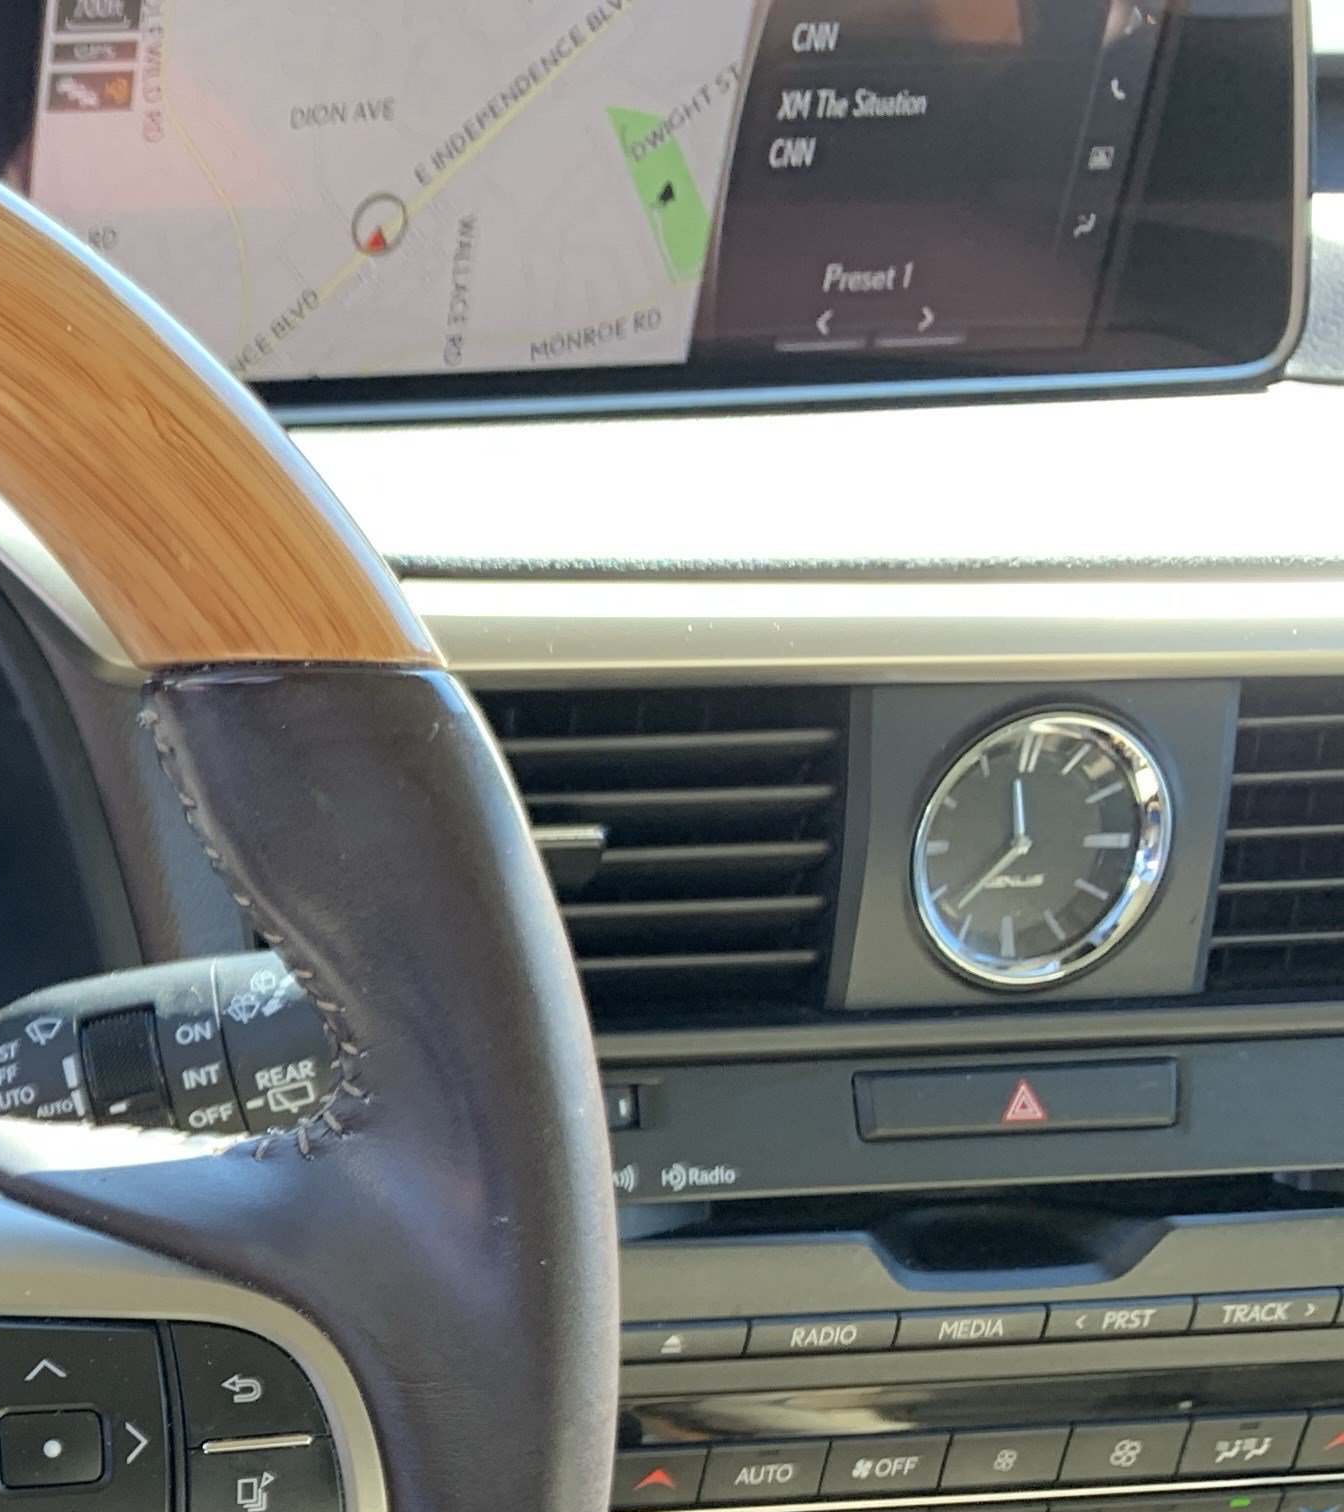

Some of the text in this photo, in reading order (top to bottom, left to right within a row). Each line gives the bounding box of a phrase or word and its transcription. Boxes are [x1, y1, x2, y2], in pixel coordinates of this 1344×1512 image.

[792, 22, 839, 52] CNN
[290, 97, 396, 130] DION AVE
[414, 163, 432, 187] E
[432, 24, 586, 174] INDEPENDENCE
[630, 62, 740, 163] DWIGHT ST
[776, 89, 928, 120] XM The Situation
[768, 138, 816, 168] CNN
[442, 216, 479, 367] WALLACE RD
[822, 262, 914, 293] Preset 1
[270, 288, 319, 340] BLVD
[529, 308, 662, 361] MONROE RD
[174, 1022, 212, 1047] ON
[181, 1062, 220, 1090] INT
[255, 1060, 316, 1091] REAR
[35, 1100, 73, 1119] AUTO
[188, 1102, 234, 1130] OFF
[1101, 1308, 1157, 1332] PRST
[1221, 1300, 1290, 1325] TRACK
[789, 1322, 858, 1349] RADIO
[938, 1316, 1006, 1342] MEDIA
[735, 1462, 794, 1487] AUTO
[874, 1455, 920, 1479] OFF
